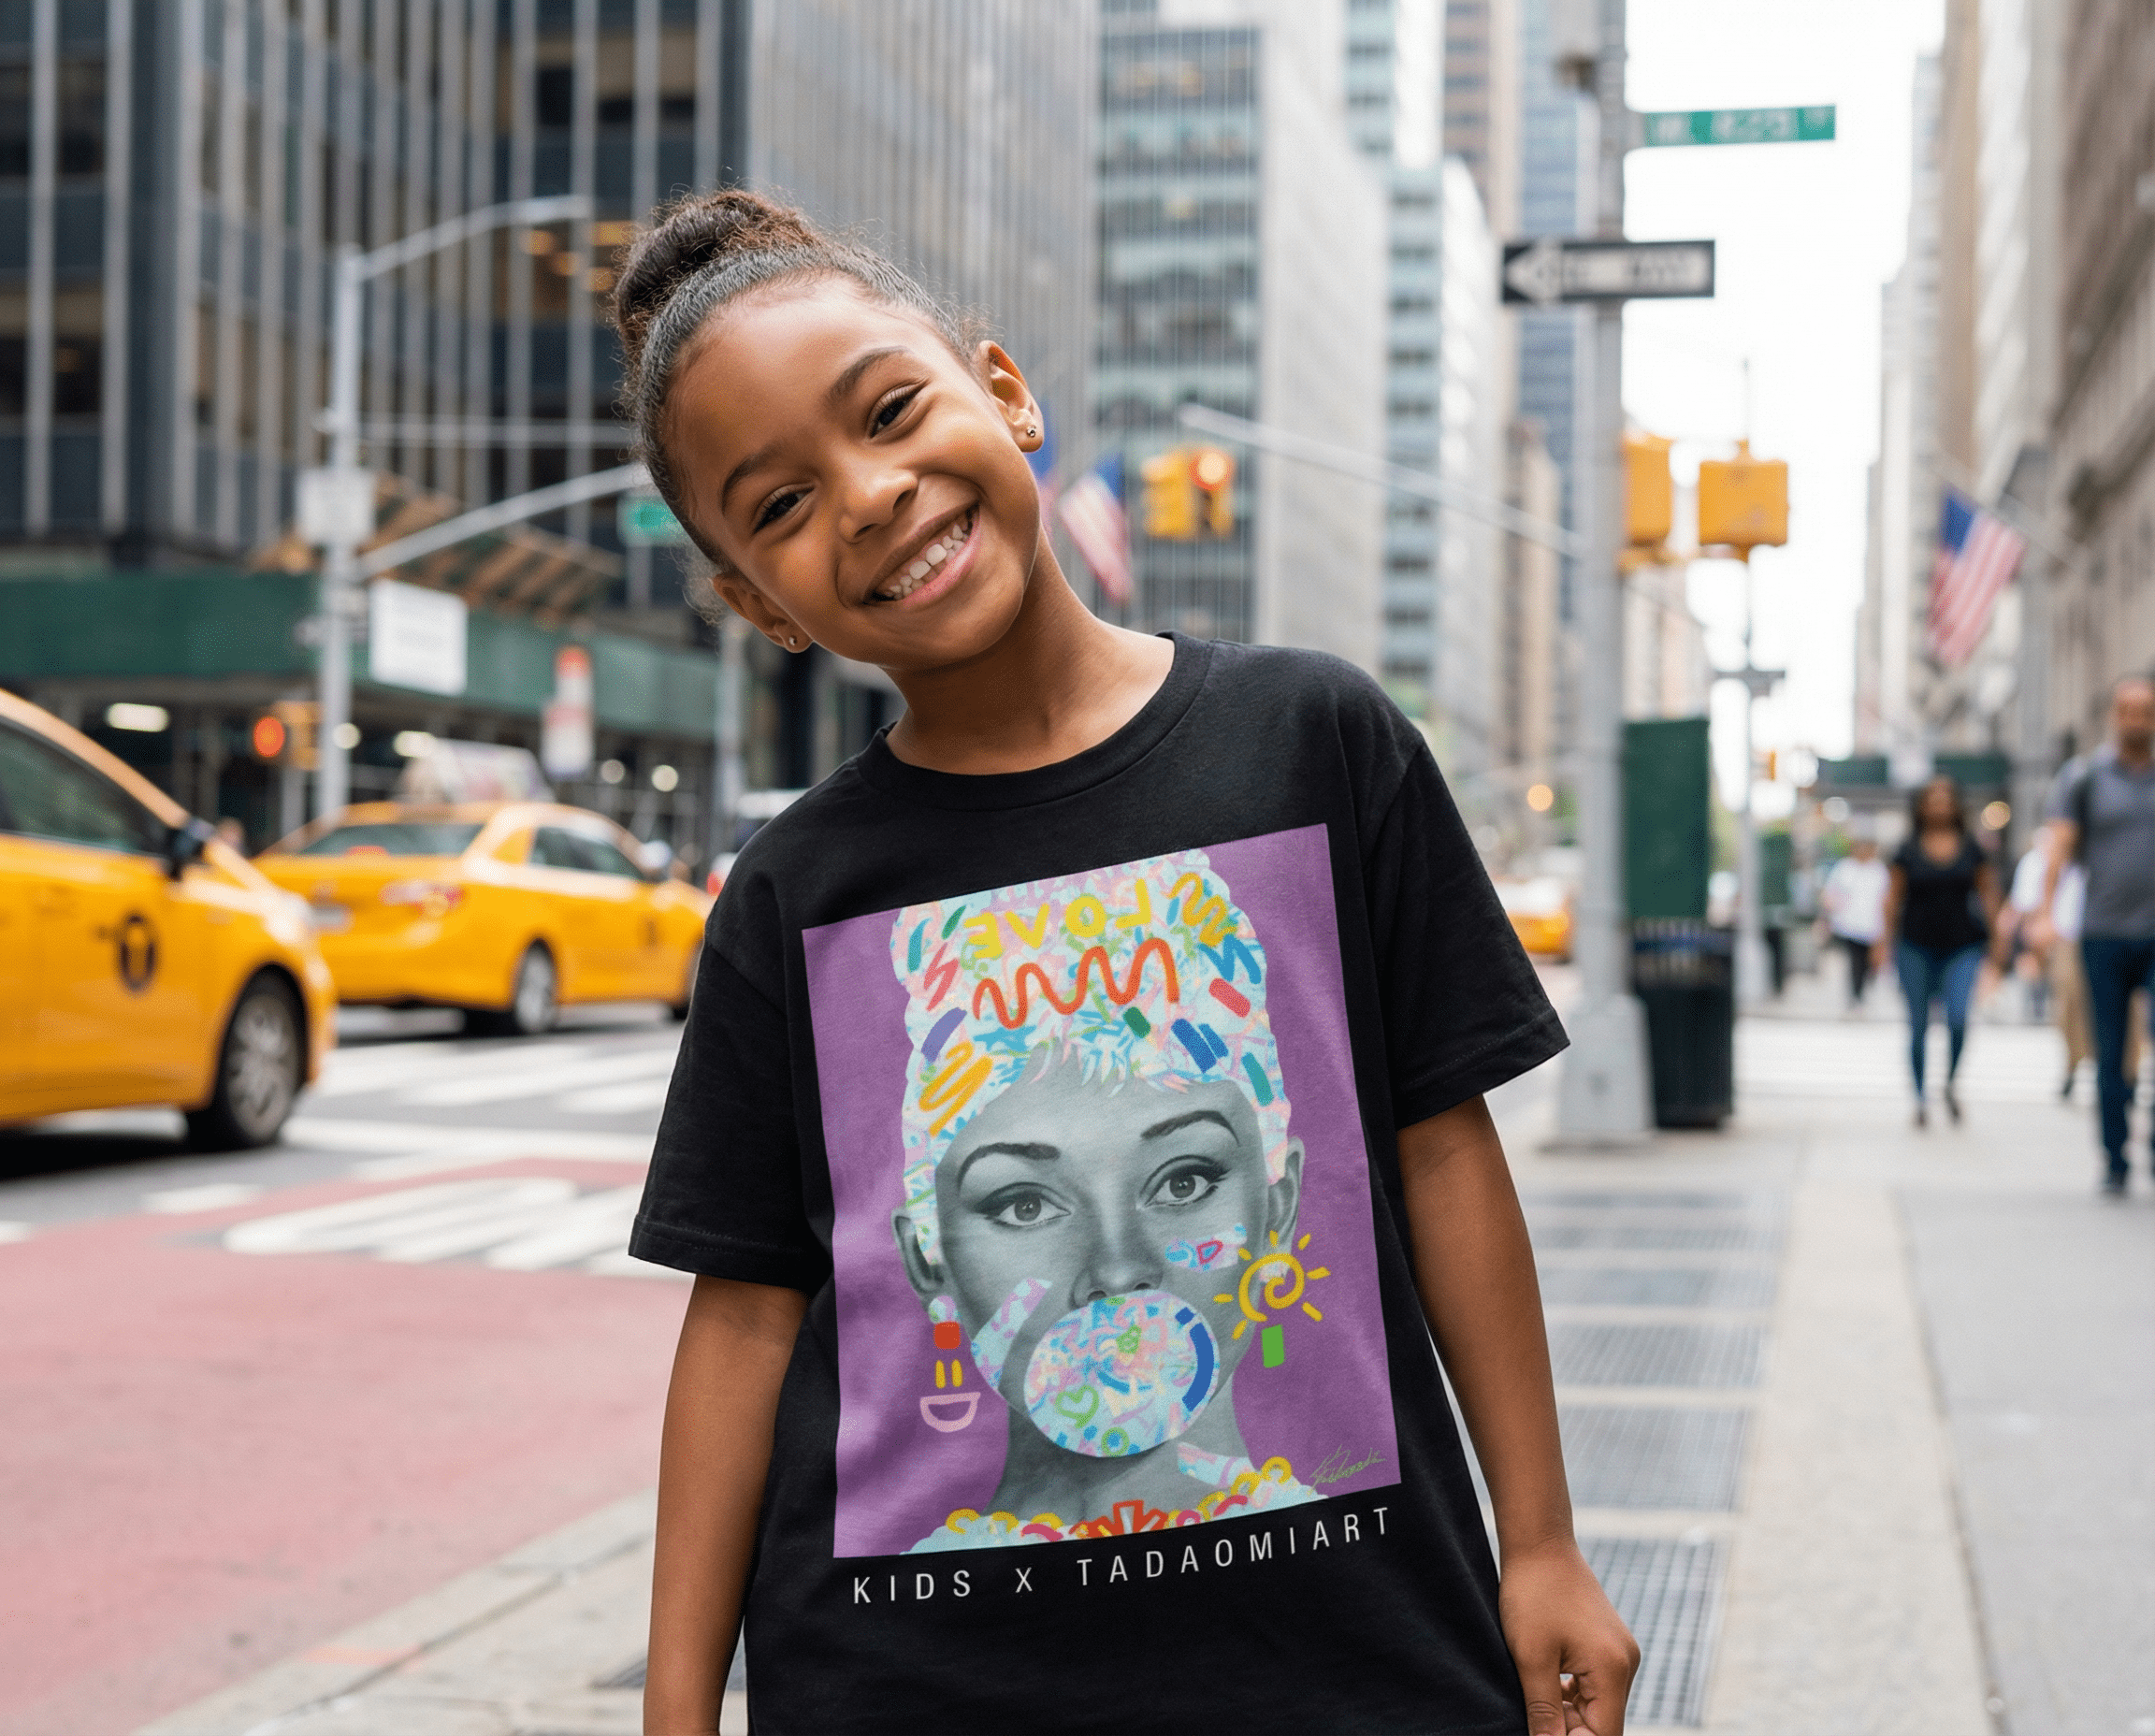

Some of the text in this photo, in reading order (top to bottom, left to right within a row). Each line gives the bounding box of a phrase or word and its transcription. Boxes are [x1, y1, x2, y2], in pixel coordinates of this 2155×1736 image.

[853, 1507, 1389, 1604] KIDS X TADAOMIART
